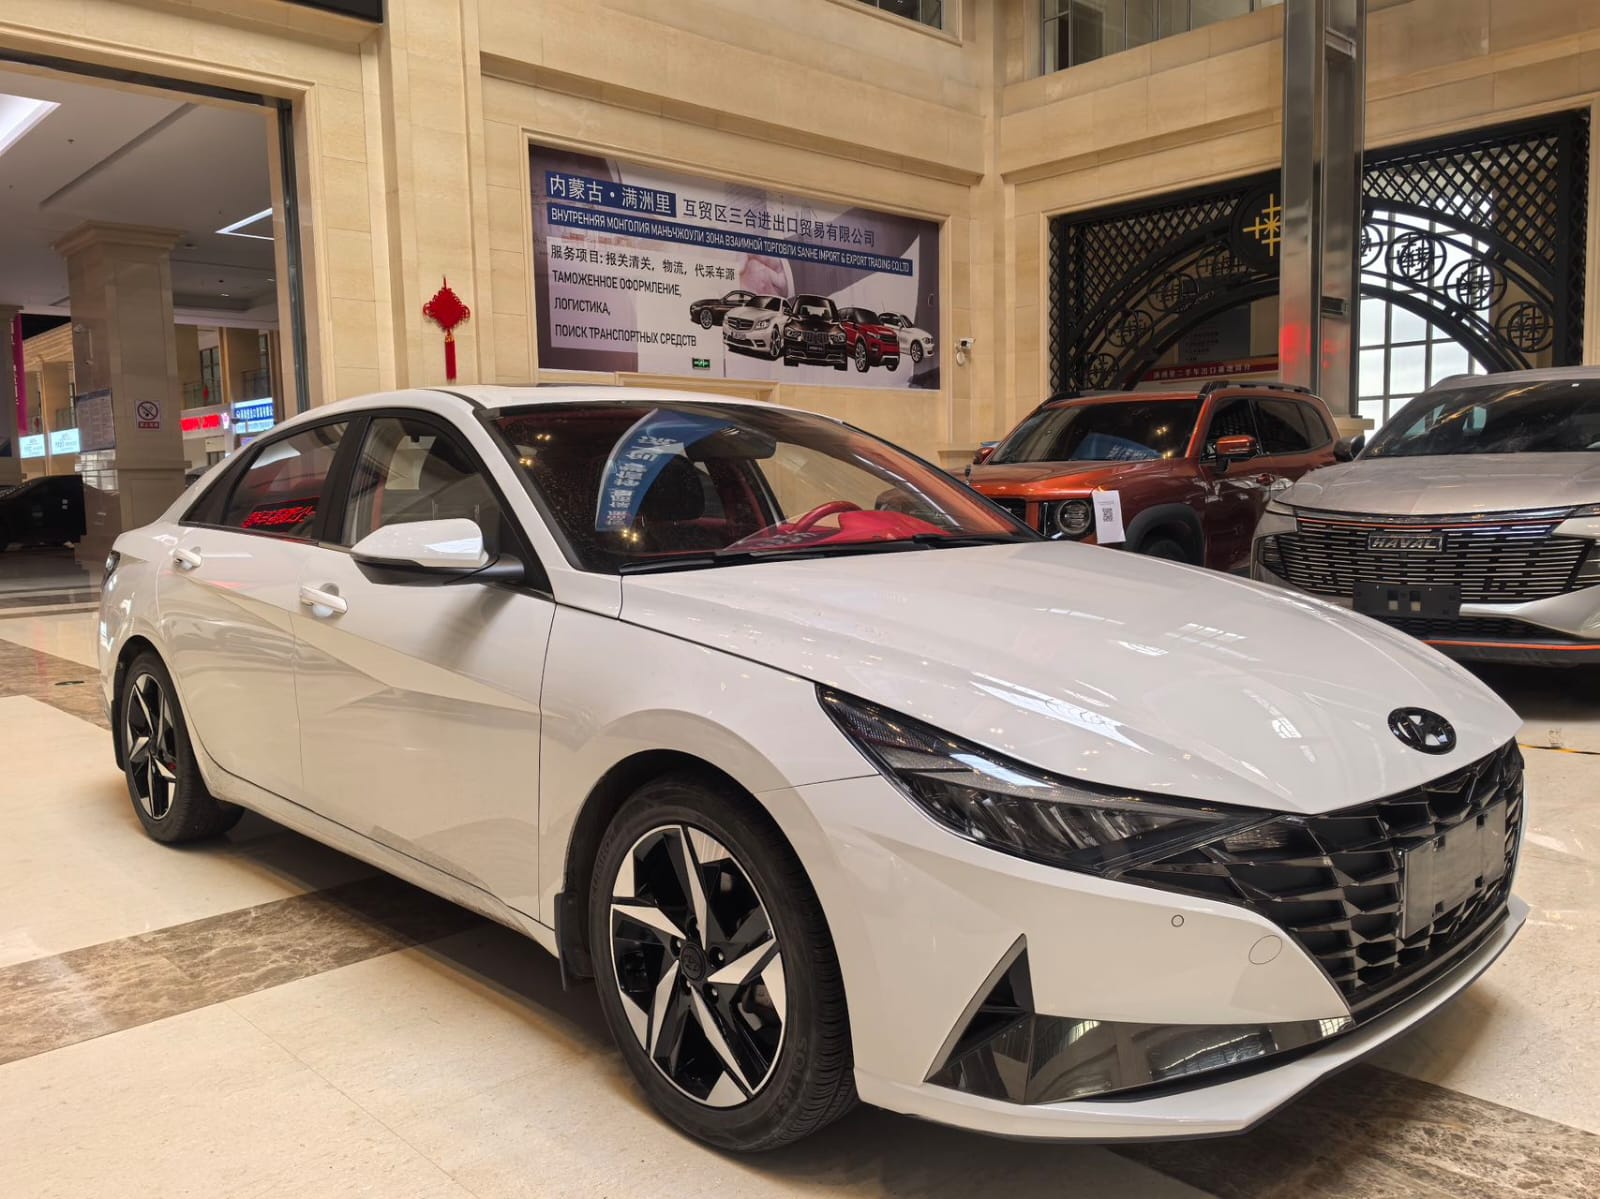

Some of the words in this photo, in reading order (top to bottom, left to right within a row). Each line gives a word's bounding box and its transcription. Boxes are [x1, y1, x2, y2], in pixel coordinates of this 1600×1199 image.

[550, 175, 671, 214] 内蒙古·满洲里
[683, 199, 875, 247] 互贸区三合进出口贸易有限公司
[551, 207, 605, 227] ВНУТРЕННЯЯ
[606, 215, 651, 233] МОНГОЛИЯ
[651, 225, 705, 242] МАНЬЧЖОУЛИ
[706, 233, 725, 246] ЗОНА
[725, 237, 762, 251] ВЗАИМНОЙ
[764, 240, 797, 255] ТОРГОВЛИ
[797, 245, 818, 260] SANHE
[819, 248, 841, 263] IMPORT
[841, 253, 846, 262] &
[846, 252, 869, 268] EXPORT
[868, 257, 891, 271] TRADING
[552, 270, 618, 289] ТАМОЖЕННОЕ
[620, 279, 682, 298] ОФОРМЛЕНИЕ,
[554, 297, 611, 316] ЛОГИСТИКА,
[555, 323, 588, 339] ПОИСК
[588, 328, 659, 344] ТРАНСПОРТНЫХ
[660, 332, 697, 347] СРЕДСТВ
[1372, 537, 1437, 549] HAVAL
